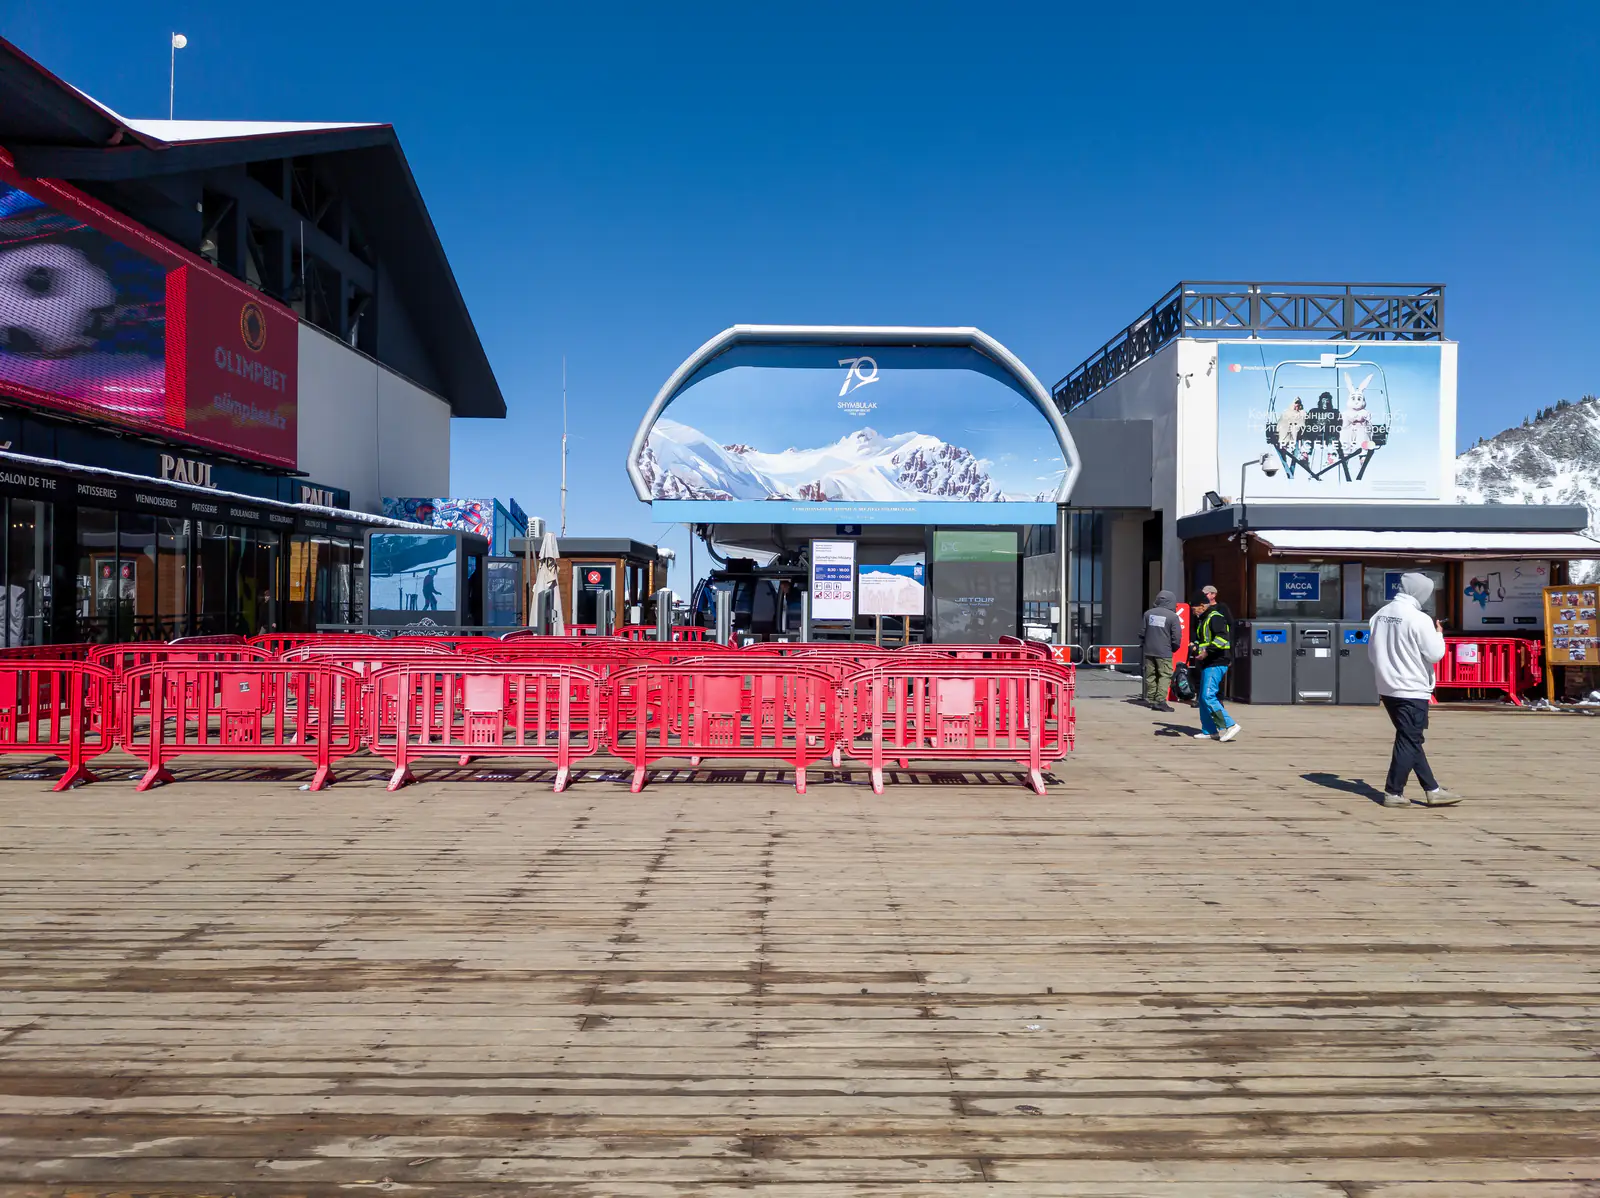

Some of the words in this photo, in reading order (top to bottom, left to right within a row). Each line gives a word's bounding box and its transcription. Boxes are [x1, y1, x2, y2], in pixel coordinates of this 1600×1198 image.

[214, 345, 288, 394] OLIMPBET
[837, 401, 878, 409] SHYMBULAK
[160, 454, 218, 488] PAUL
[0, 471, 27, 486] SALON
[28, 476, 40, 488] DE
[41, 478, 57, 490] THE
[77, 484, 117, 499] PATISSERIES
[135, 493, 177, 508] VIENNOISERIES
[191, 502, 218, 514] PATISSERIE
[230, 508, 260, 520] BOULANGERIE
[1285, 582, 1313, 590] КАССА
